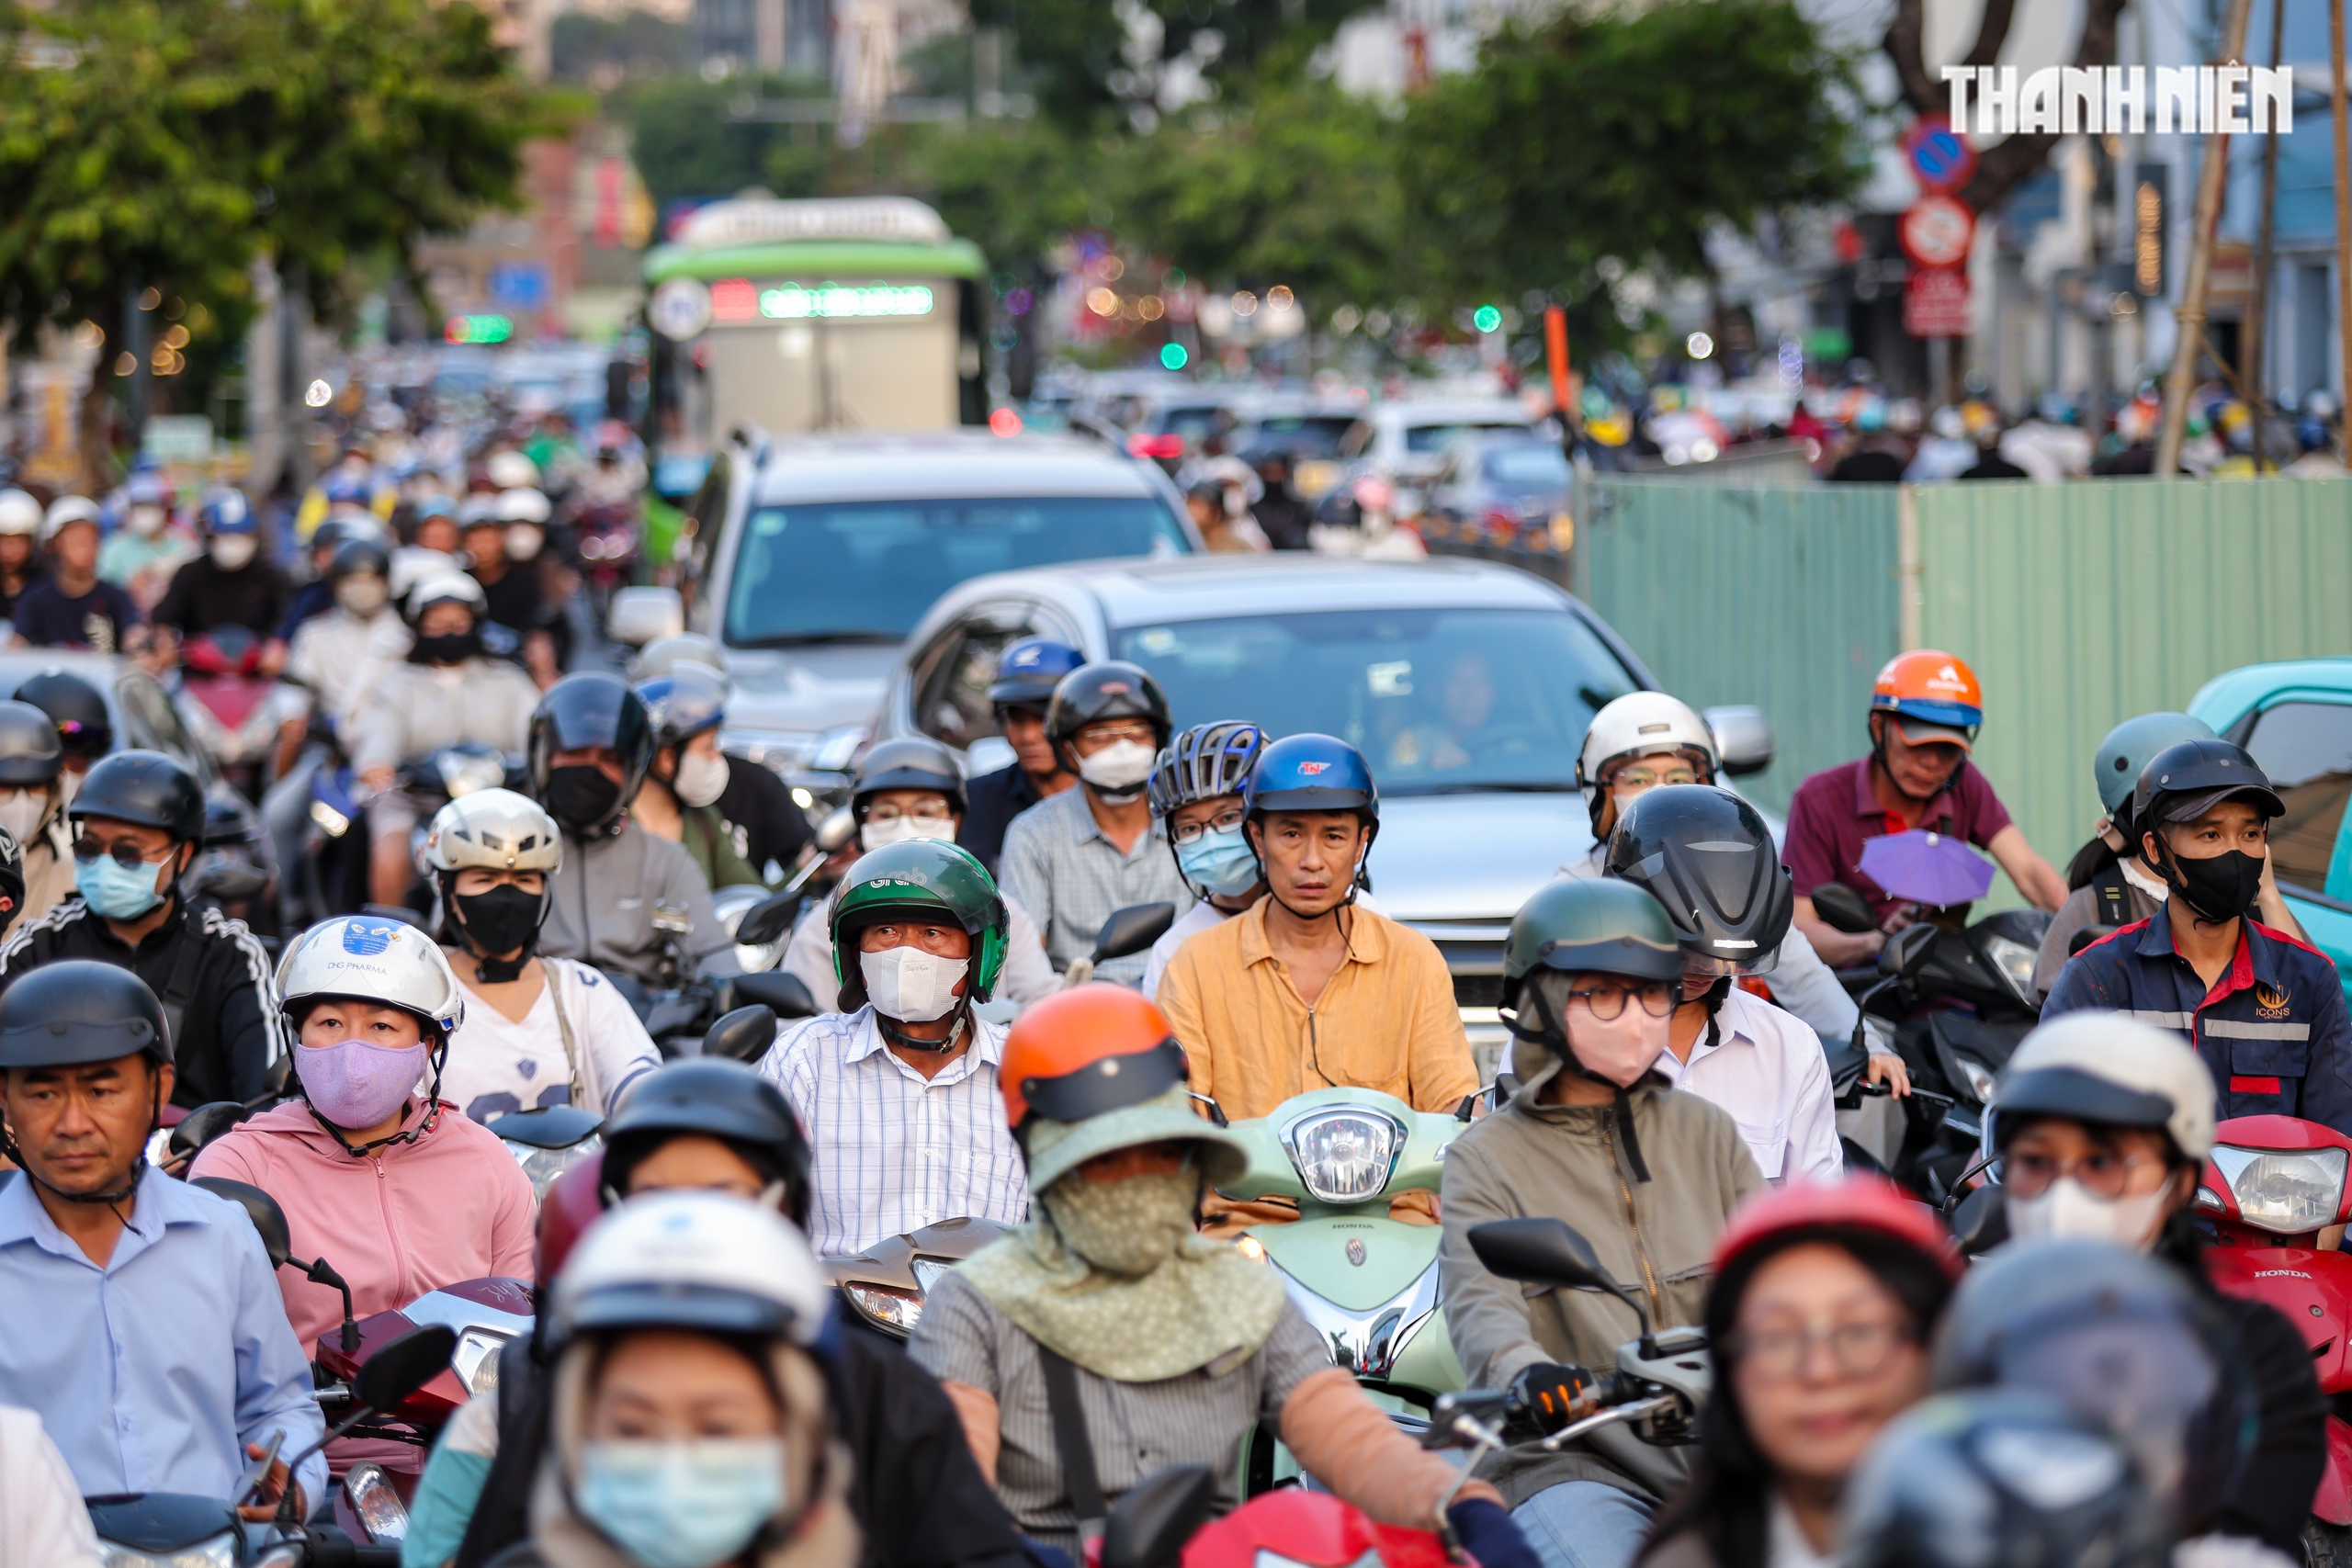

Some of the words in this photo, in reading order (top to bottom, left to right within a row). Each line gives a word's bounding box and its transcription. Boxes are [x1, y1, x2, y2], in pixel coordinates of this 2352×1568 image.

[1301, 761, 1321, 774] TN
[869, 866, 928, 888] Grab
[346, 962, 387, 976] PHARMA
[2256, 1007, 2290, 1017] ICONS
[2254, 1269, 2313, 1280] HONDA
